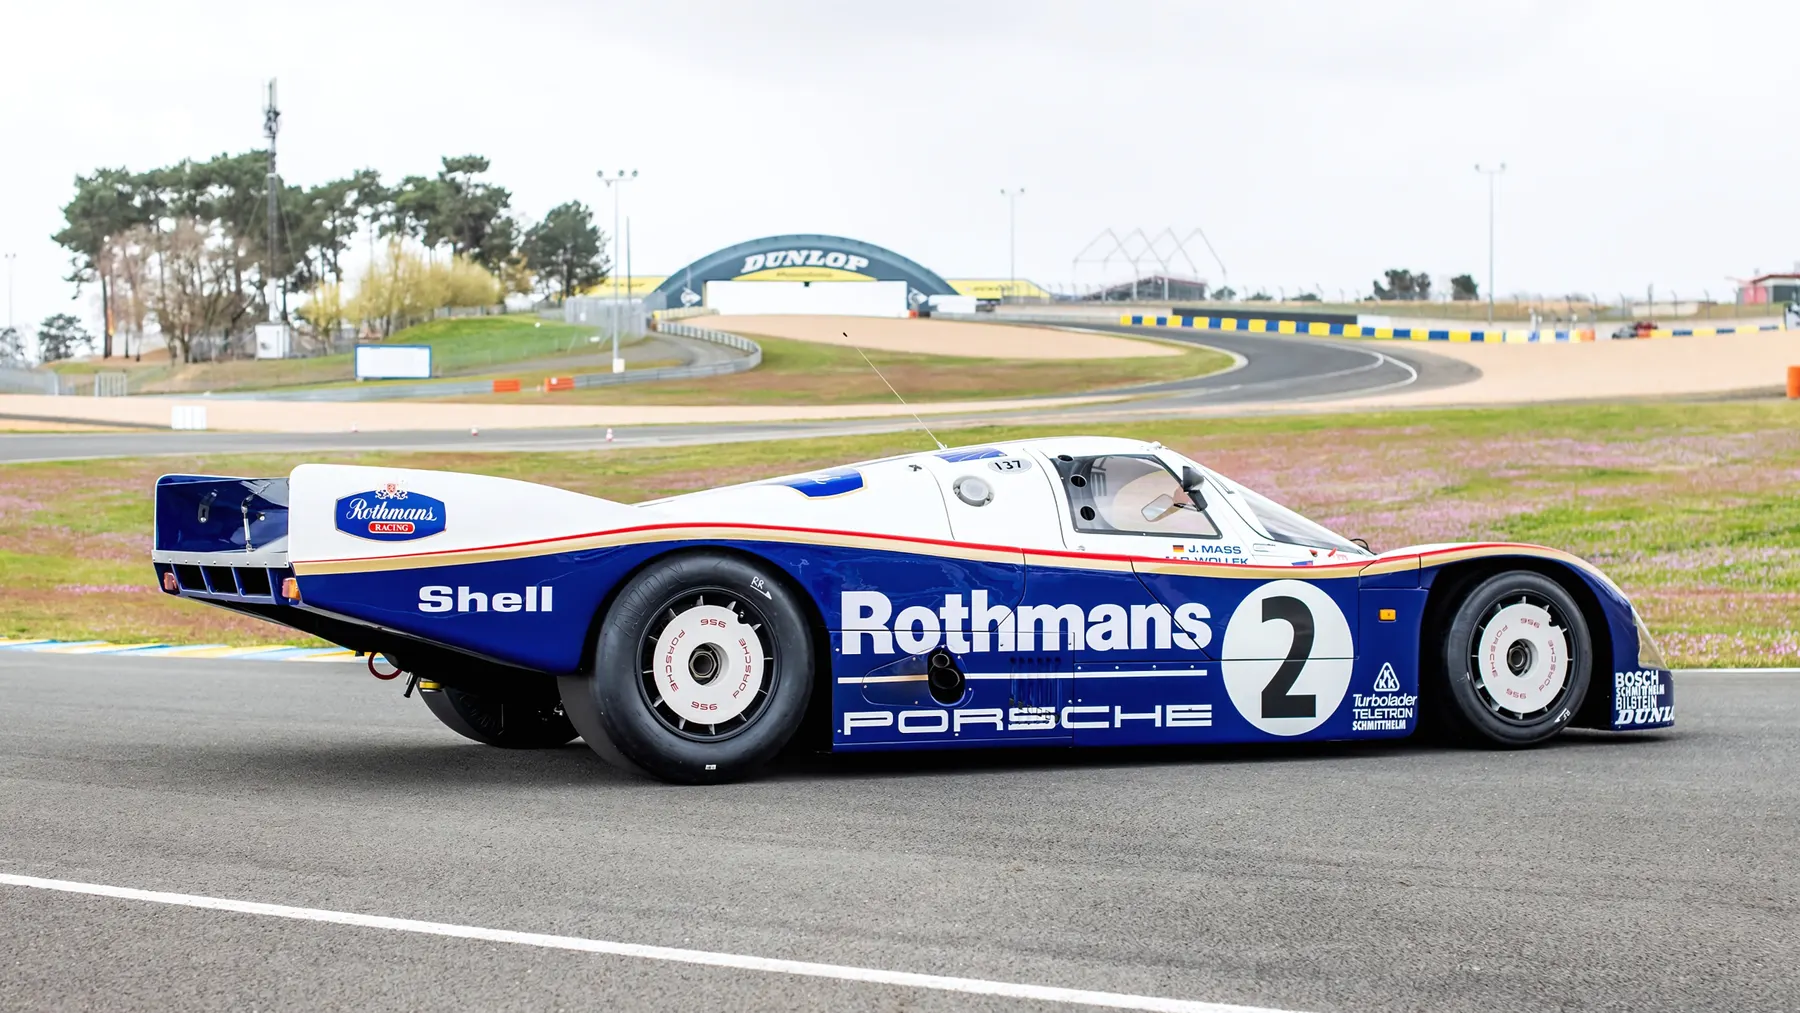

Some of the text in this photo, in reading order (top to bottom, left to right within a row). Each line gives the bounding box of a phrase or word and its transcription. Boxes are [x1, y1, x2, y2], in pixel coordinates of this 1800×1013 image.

[740, 250, 869, 273] DUNLOP
[994, 460, 1022, 471] 137
[346, 498, 437, 521] Rothmans
[375, 524, 409, 532] RACING
[1189, 545, 1242, 554] J. MASS
[751, 576, 765, 590] RR
[418, 585, 553, 613] Shell
[700, 618, 726, 629] 956
[841, 589, 1212, 655] Rothmans
[1520, 617, 1541, 629] 956
[1261, 596, 1317, 719] 2
[1489, 625, 1509, 678] PORSCHE
[665, 629, 686, 692] PORSCHE
[1538, 640, 1557, 692] PORSCHE
[732, 638, 752, 699] PORSCHE
[1615, 670, 1659, 688] BOSCH
[1506, 688, 1527, 700] 956
[1616, 684, 1665, 697] SCHMITTHELM
[691, 701, 718, 711] 956
[1352, 692, 1418, 707] Turbolader
[1616, 694, 1657, 710] BILSTEIN
[844, 704, 1212, 735] PORSCHE
[1352, 707, 1413, 719] TELETRON
[1352, 719, 1407, 731] SCHMITTHELM
